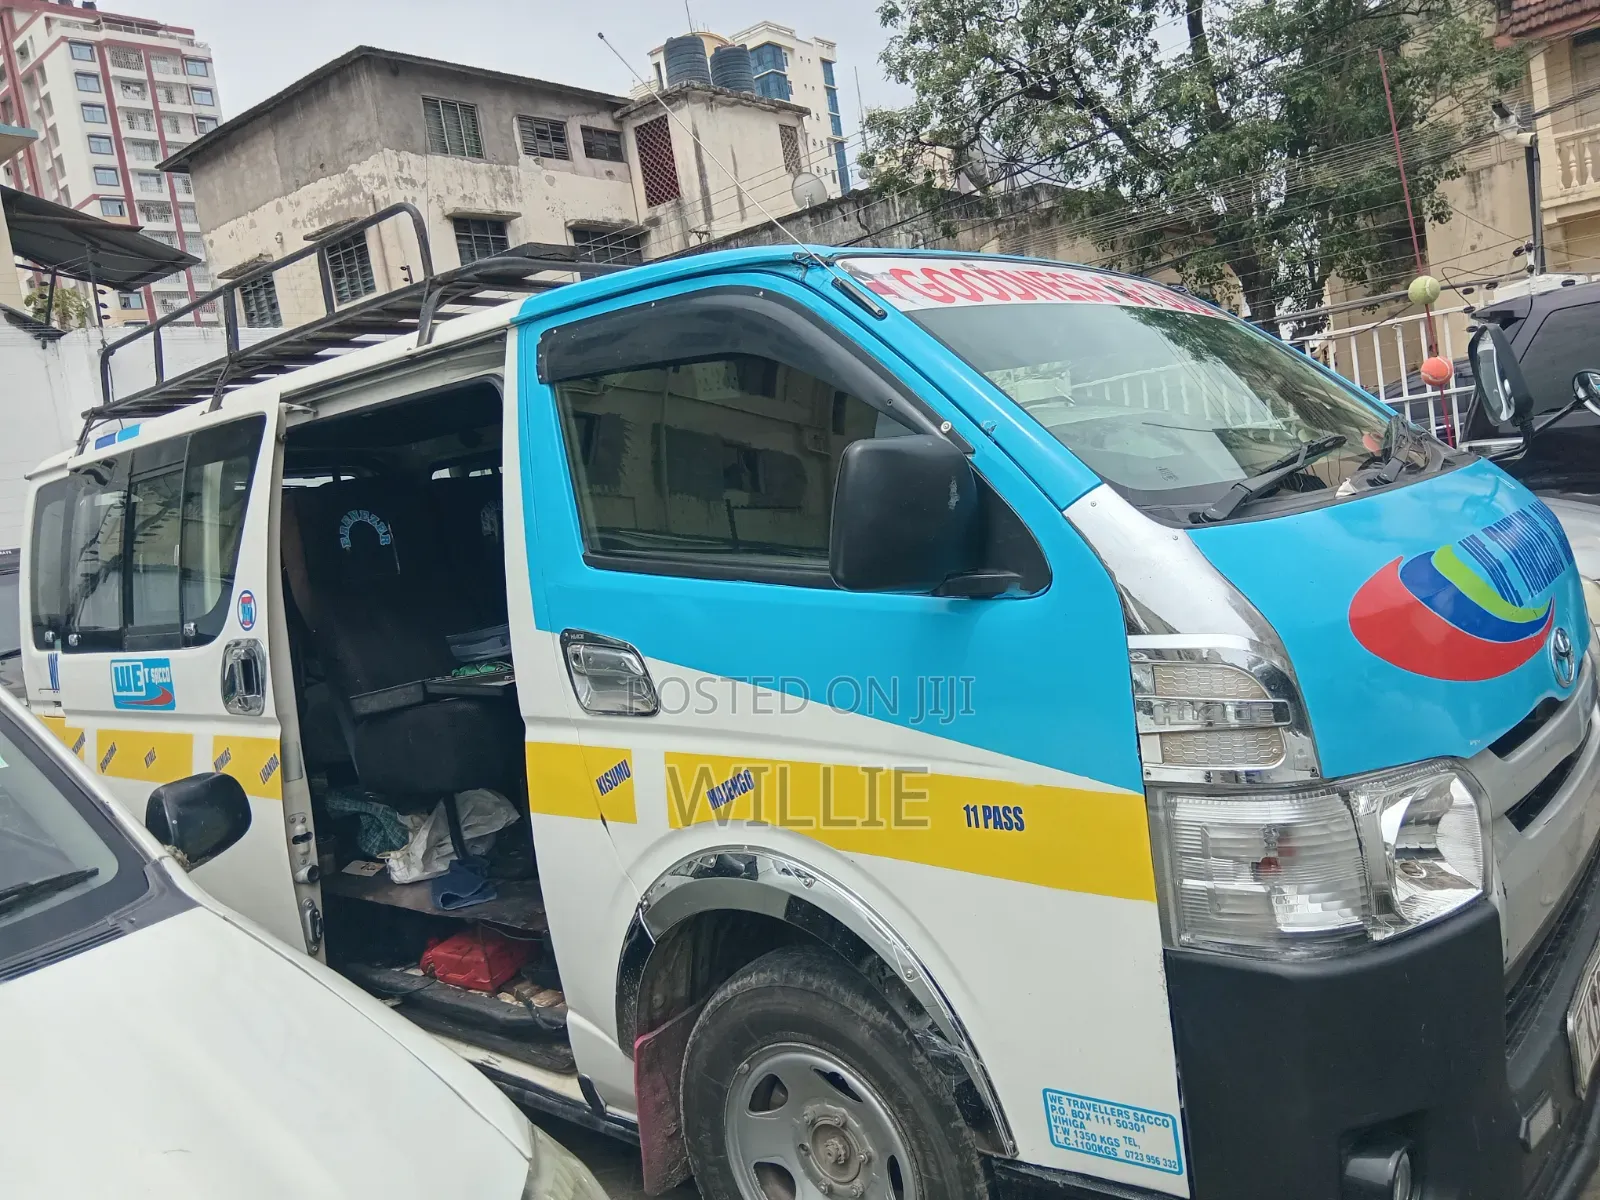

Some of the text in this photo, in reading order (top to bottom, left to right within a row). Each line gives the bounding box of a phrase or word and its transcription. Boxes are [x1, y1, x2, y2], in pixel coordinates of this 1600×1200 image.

[889, 267, 1120, 304] GOODNESS
[114, 665, 143, 692] WE
[151, 667, 171, 685] SACCO
[259, 753, 280, 785] LUANDA
[596, 759, 632, 796] KISUMU
[706, 769, 755, 810] MAJENGO
[963, 804, 1025, 831] 11 PASS
[1048, 1093, 1170, 1128] WE TRAVELLERS SACCO
[1050, 1104, 1069, 1116] P.O.
[1071, 1109, 1091, 1121] BOX
[1051, 1114, 1086, 1130] VIHIGA
[1053, 1124, 1120, 1147] T.W 1350 KGS
[1124, 1149, 1178, 1169] 0723 956 332
